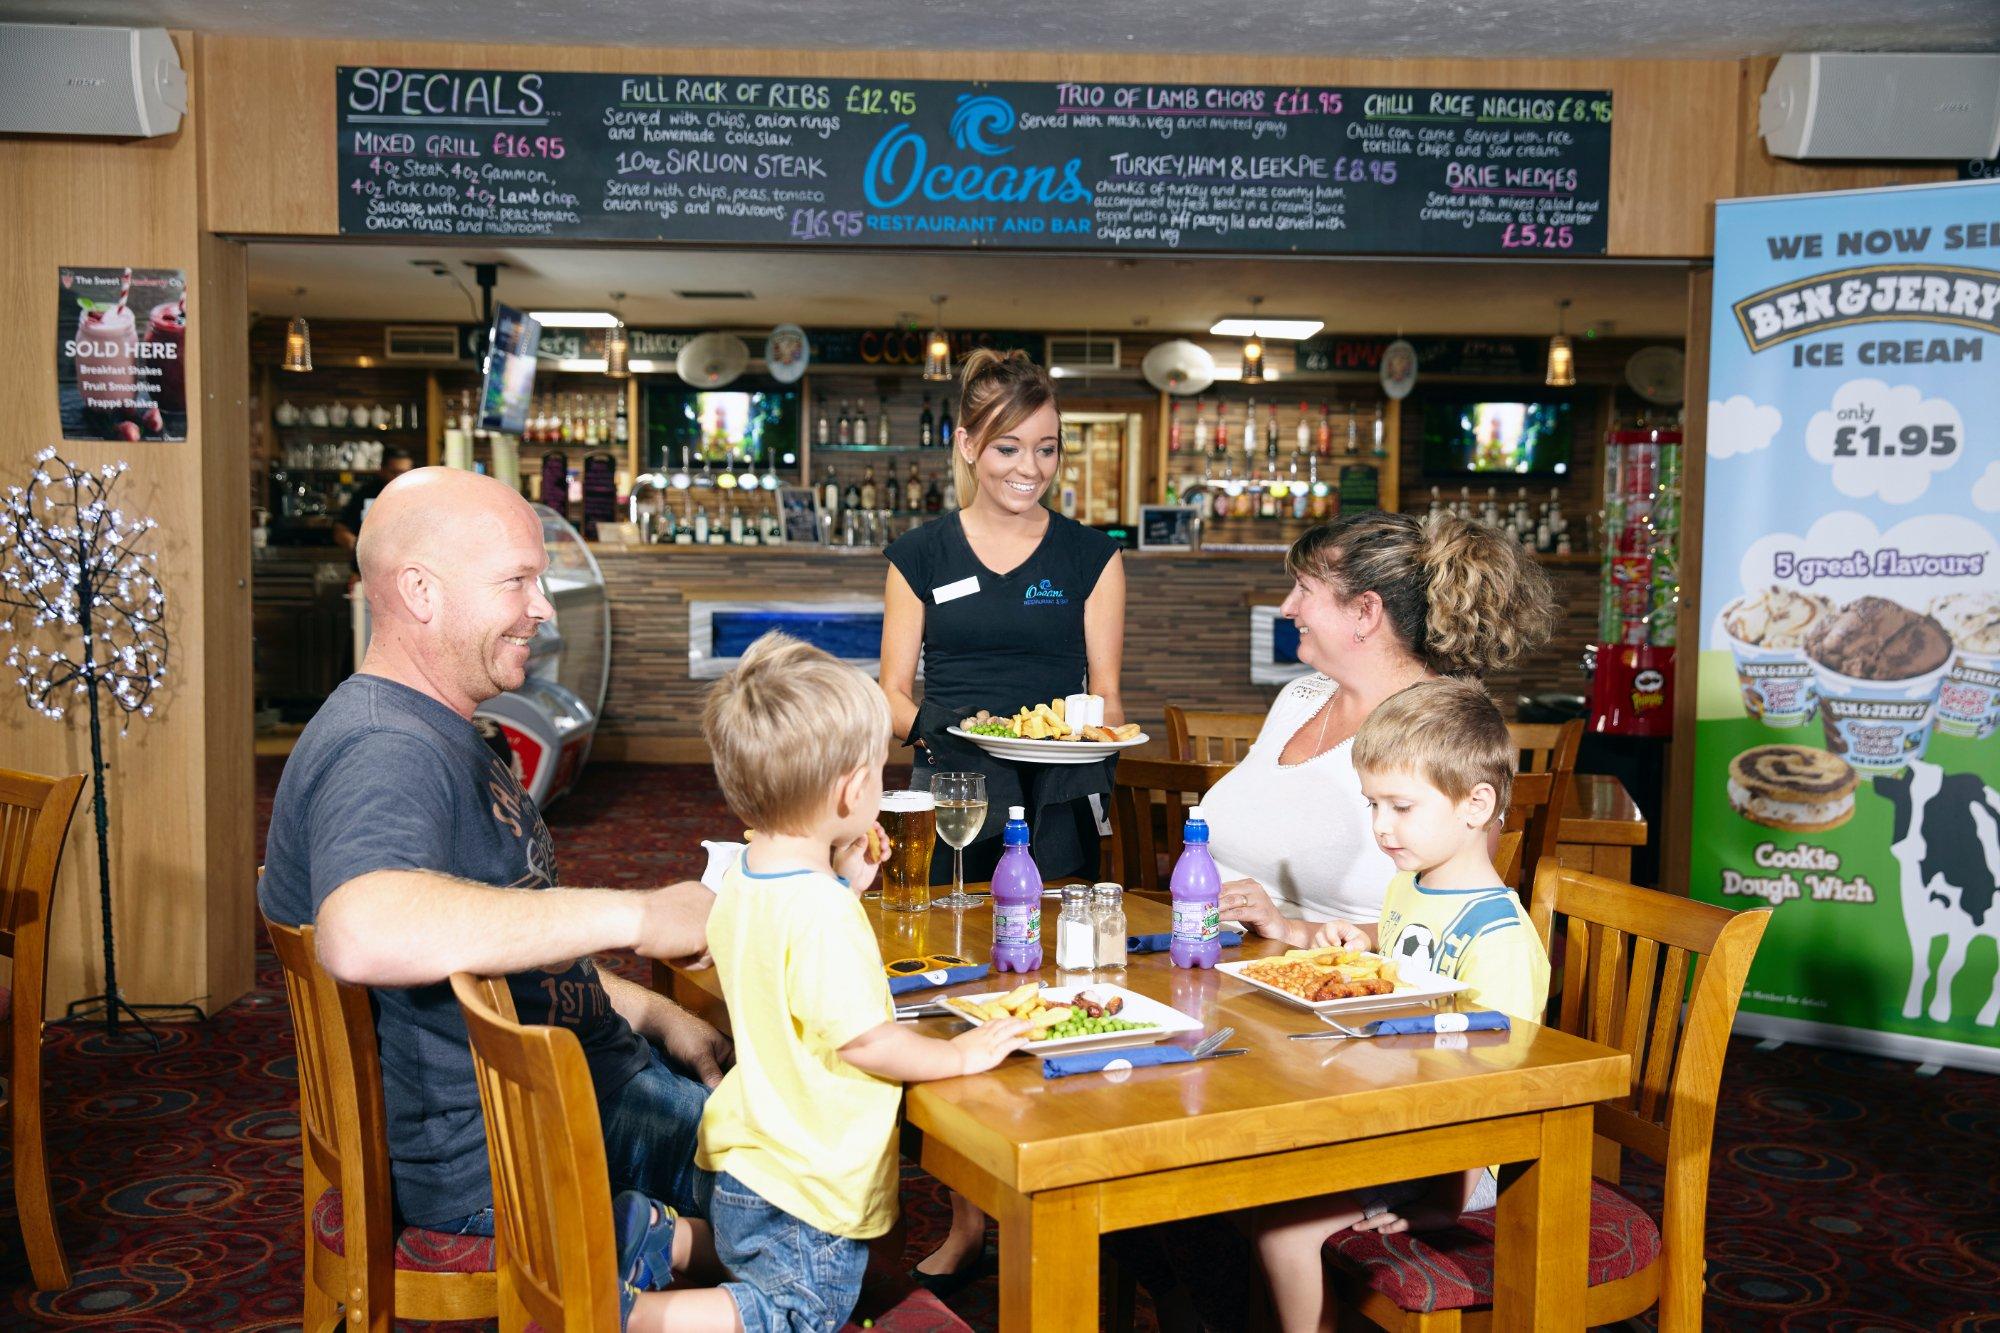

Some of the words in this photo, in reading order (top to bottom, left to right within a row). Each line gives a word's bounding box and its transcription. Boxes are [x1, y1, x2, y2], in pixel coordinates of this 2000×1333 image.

[621, 77, 670, 103] FULL
[676, 79, 728, 104] RACK
[736, 83, 763, 105] OF
[768, 82, 830, 109] RIBS
[846, 85, 917, 115] £12.95
[1056, 82, 1105, 106] TRIO
[1114, 87, 1142, 109] OF
[1147, 87, 1199, 110] LAMB
[1205, 88, 1266, 110] CHOPS
[1274, 91, 1343, 115] £11.95
[1364, 94, 1413, 115] CHILLI
[1429, 92, 1475, 117] RICE
[1482, 97, 1555, 121] NACHOS
[1558, 98, 1612, 123] £8.95
[603, 107, 660, 126] Served
[670, 110, 701, 126] with
[755, 112, 798, 129] onion
[800, 114, 840, 139] rings
[608, 126, 636, 140] and
[644, 126, 716, 142] homemade
[1019, 112, 1067, 130] Served
[1147, 115, 1173, 139] veg
[1177, 117, 1207, 129] and
[1252, 120, 1287, 140] gravy
[354, 131, 415, 154] MIXED
[426, 134, 481, 158] GRILL
[493, 132, 566, 160] £16.95
[1388, 126, 1414, 140] con
[1514, 130, 1544, 144] with
[1547, 129, 1574, 145] rice
[1455, 144, 1482, 158] and
[754, 153, 828, 179] STEAK
[863, 122, 1094, 209] Oceans
[1231, 155, 1248, 180] &
[1250, 155, 1298, 179] LEEK
[1298, 154, 1328, 178] PIE
[1334, 156, 1398, 185] £8.95
[1445, 161, 1500, 187] BRIE
[1505, 166, 1577, 192] WEDGES
[387, 180, 421, 197] Pork
[499, 186, 540, 205] Lamb
[606, 179, 651, 197] Served
[654, 182, 685, 198] with
[1150, 181, 1166, 197] of
[1167, 184, 1208, 201] turkey
[1210, 184, 1236, 196] and
[428, 202, 459, 216] with
[602, 198, 642, 212] onion
[644, 199, 679, 219] rings
[684, 199, 710, 215] and
[1426, 191, 1466, 207] Served
[1468, 194, 1495, 207] with
[1575, 200, 1600, 212] and
[456, 221, 483, 233] and
[789, 207, 864, 240] £16.95
[866, 213, 997, 233] RESTAURANT
[1003, 216, 1045, 233] AND
[1051, 217, 1091, 234] BAR
[1248, 213, 1273, 229] and
[1315, 215, 1347, 231] with
[1134, 225, 1157, 240] and
[1160, 228, 1180, 248] veg
[1502, 223, 1575, 248] £5.25
[1767, 233, 1823, 261] WE
[1837, 227, 1931, 256] NOW
[75, 275, 93, 286] The
[93, 275, 120, 287] Sweet
[65, 340, 119, 358] SOLD
[124, 342, 178, 359] HERE
[1793, 342, 1843, 367] ICE
[1858, 338, 1983, 366] CREAM
[80, 364, 126, 375] Breakfast
[128, 365, 163, 376] Shakes
[83, 381, 106, 391] Fruit
[108, 381, 162, 393] Smoothies
[124, 398, 159, 409] Shakes
[1837, 402, 1875, 424] only
[1833, 424, 1957, 457] £1.95
[1774, 551, 1794, 578] 5
[1797, 550, 1869, 586] great
[1874, 549, 1984, 577] flavours
[1723, 871, 1800, 904] Dough
